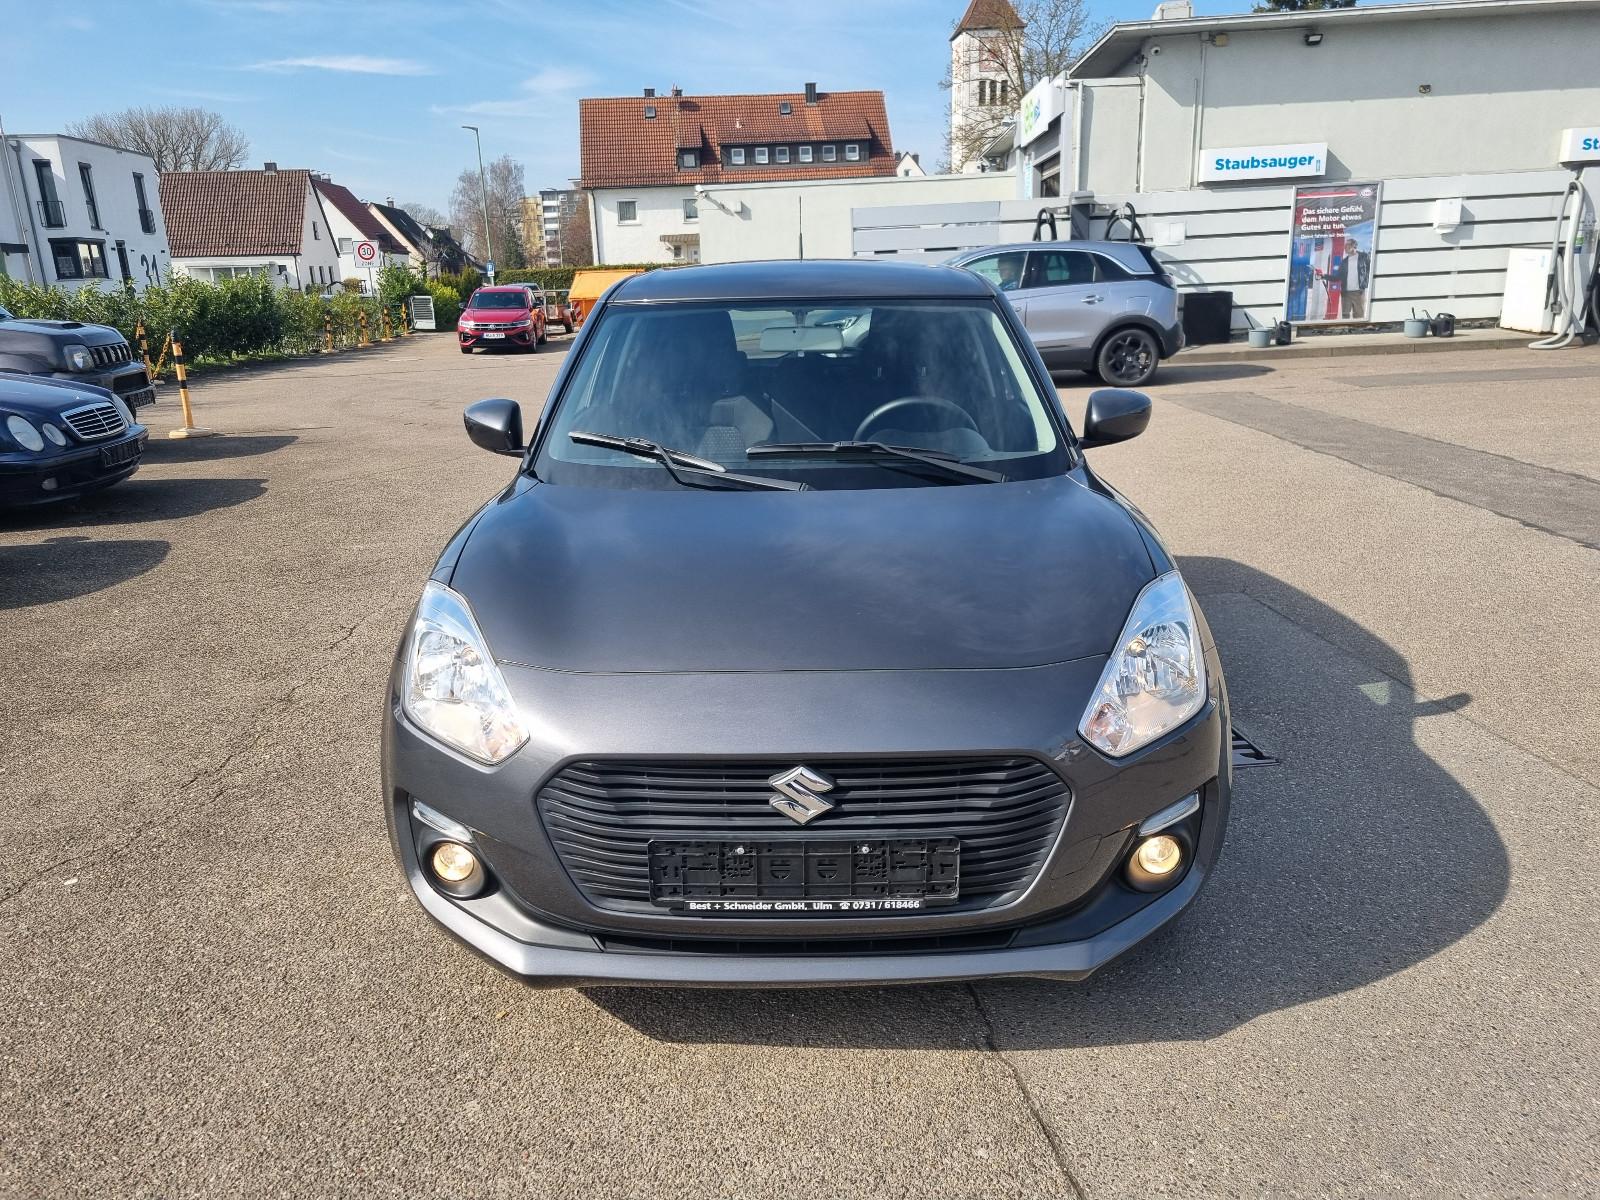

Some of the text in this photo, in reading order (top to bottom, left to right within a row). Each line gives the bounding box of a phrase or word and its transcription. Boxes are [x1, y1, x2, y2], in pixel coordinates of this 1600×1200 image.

[1582, 138, 1600, 150] St
[1215, 155, 1315, 171] Staubsauger
[1316, 206, 1339, 214] sichere
[1301, 215, 1317, 223] dem
[361, 247, 372, 256] 30
[689, 902, 711, 910] Best
[723, 902, 773, 910] Schneider
[812, 902, 833, 910] Ulm
[852, 901, 876, 910] 0731
[884, 900, 920, 909] 618466
